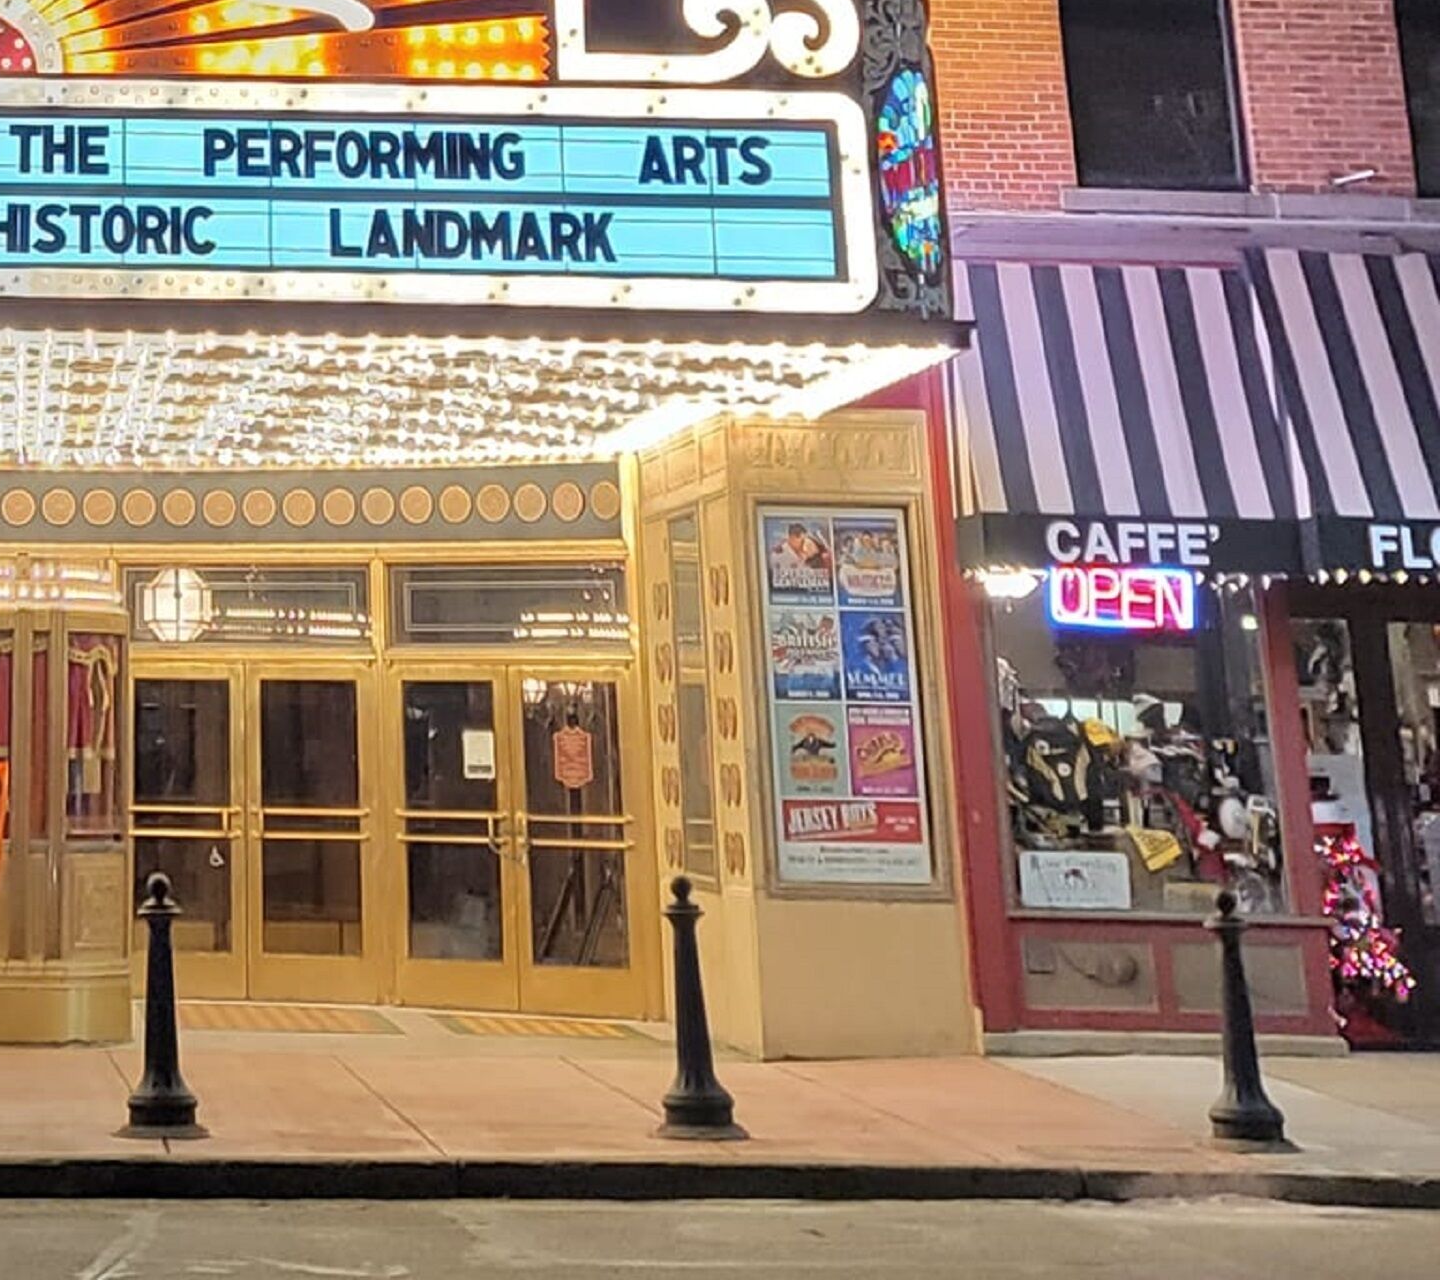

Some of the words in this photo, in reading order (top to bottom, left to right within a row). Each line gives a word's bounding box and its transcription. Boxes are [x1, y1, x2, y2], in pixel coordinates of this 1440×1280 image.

[9, 124, 110, 175] THE
[203, 128, 526, 179] PERFORMING
[639, 134, 772, 185] ARTS
[329, 207, 618, 263] LANDMARK
[1046, 520, 1220, 566] CAFFE'
[1052, 566, 1194, 629] OPEN
